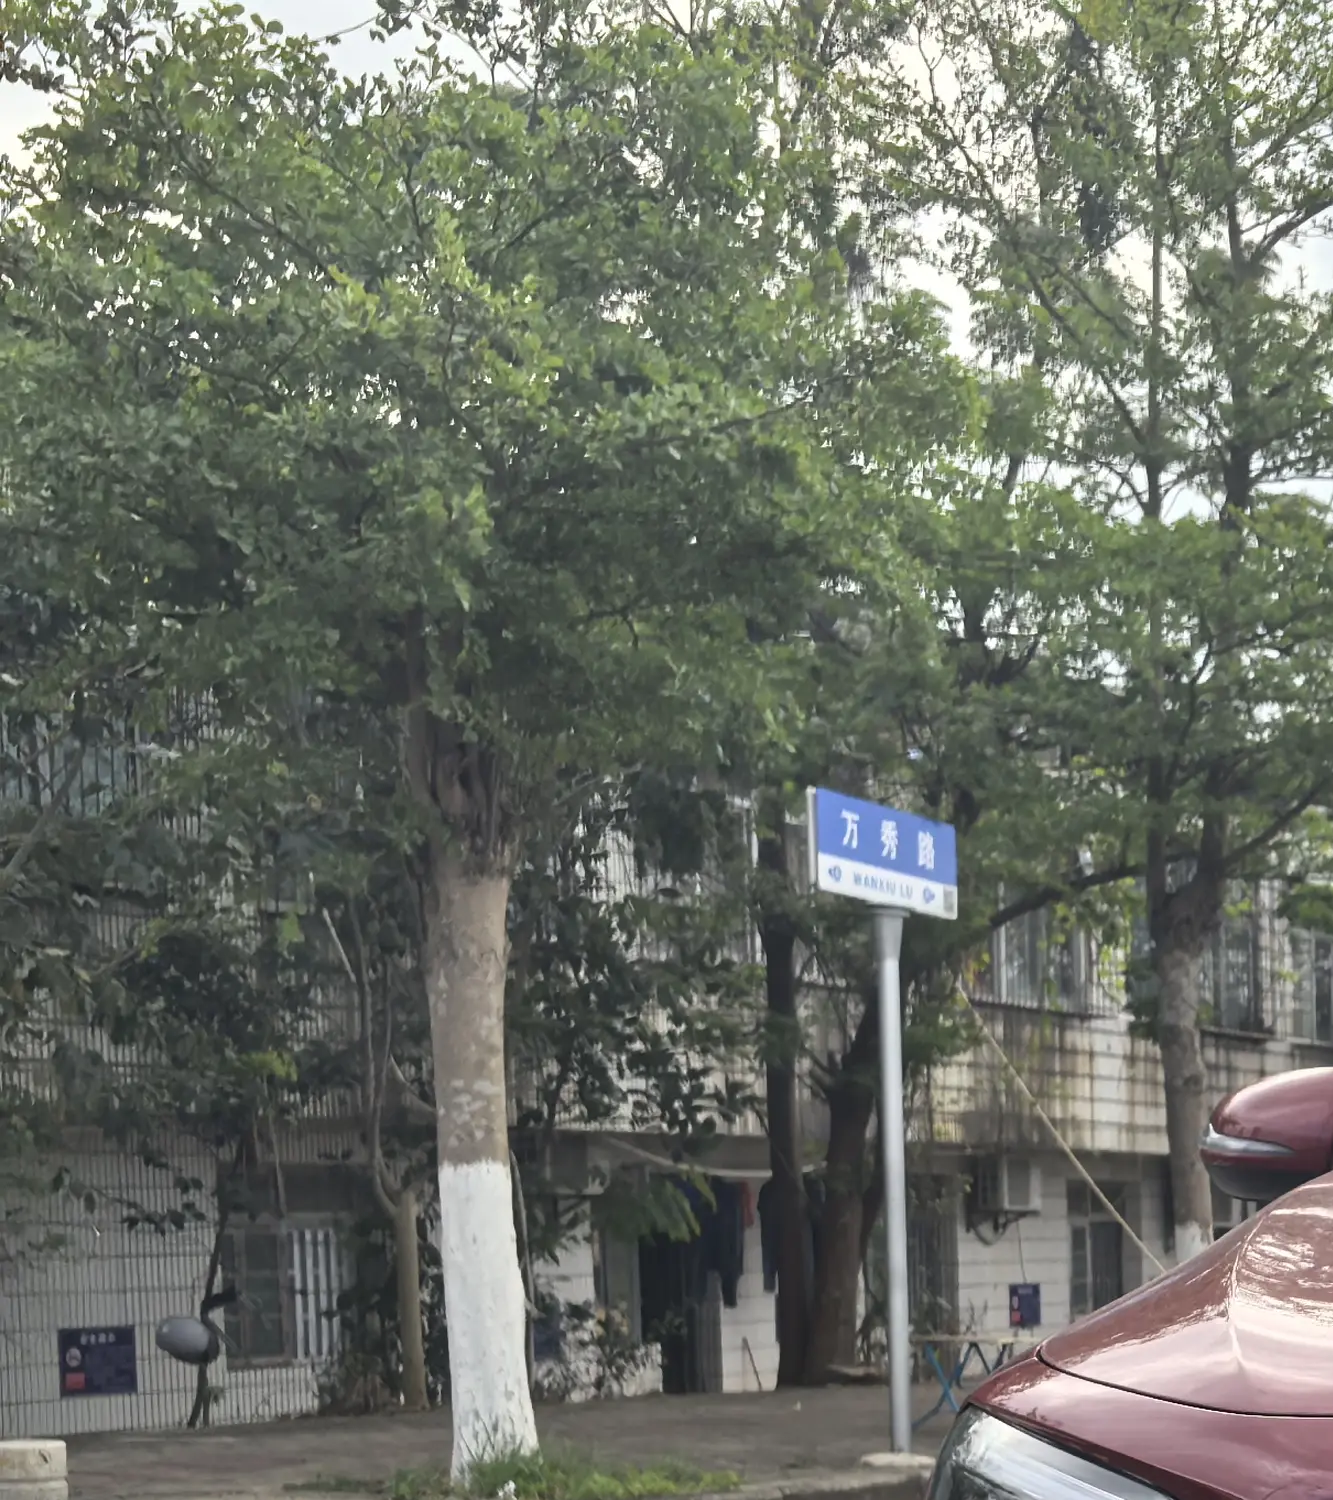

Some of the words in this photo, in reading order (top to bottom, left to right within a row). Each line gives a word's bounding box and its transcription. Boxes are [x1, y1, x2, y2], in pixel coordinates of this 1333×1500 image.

[840, 808, 935, 870] 万秀路
[853, 872, 896, 896] WANXIU
[900, 883, 913, 899] LU
